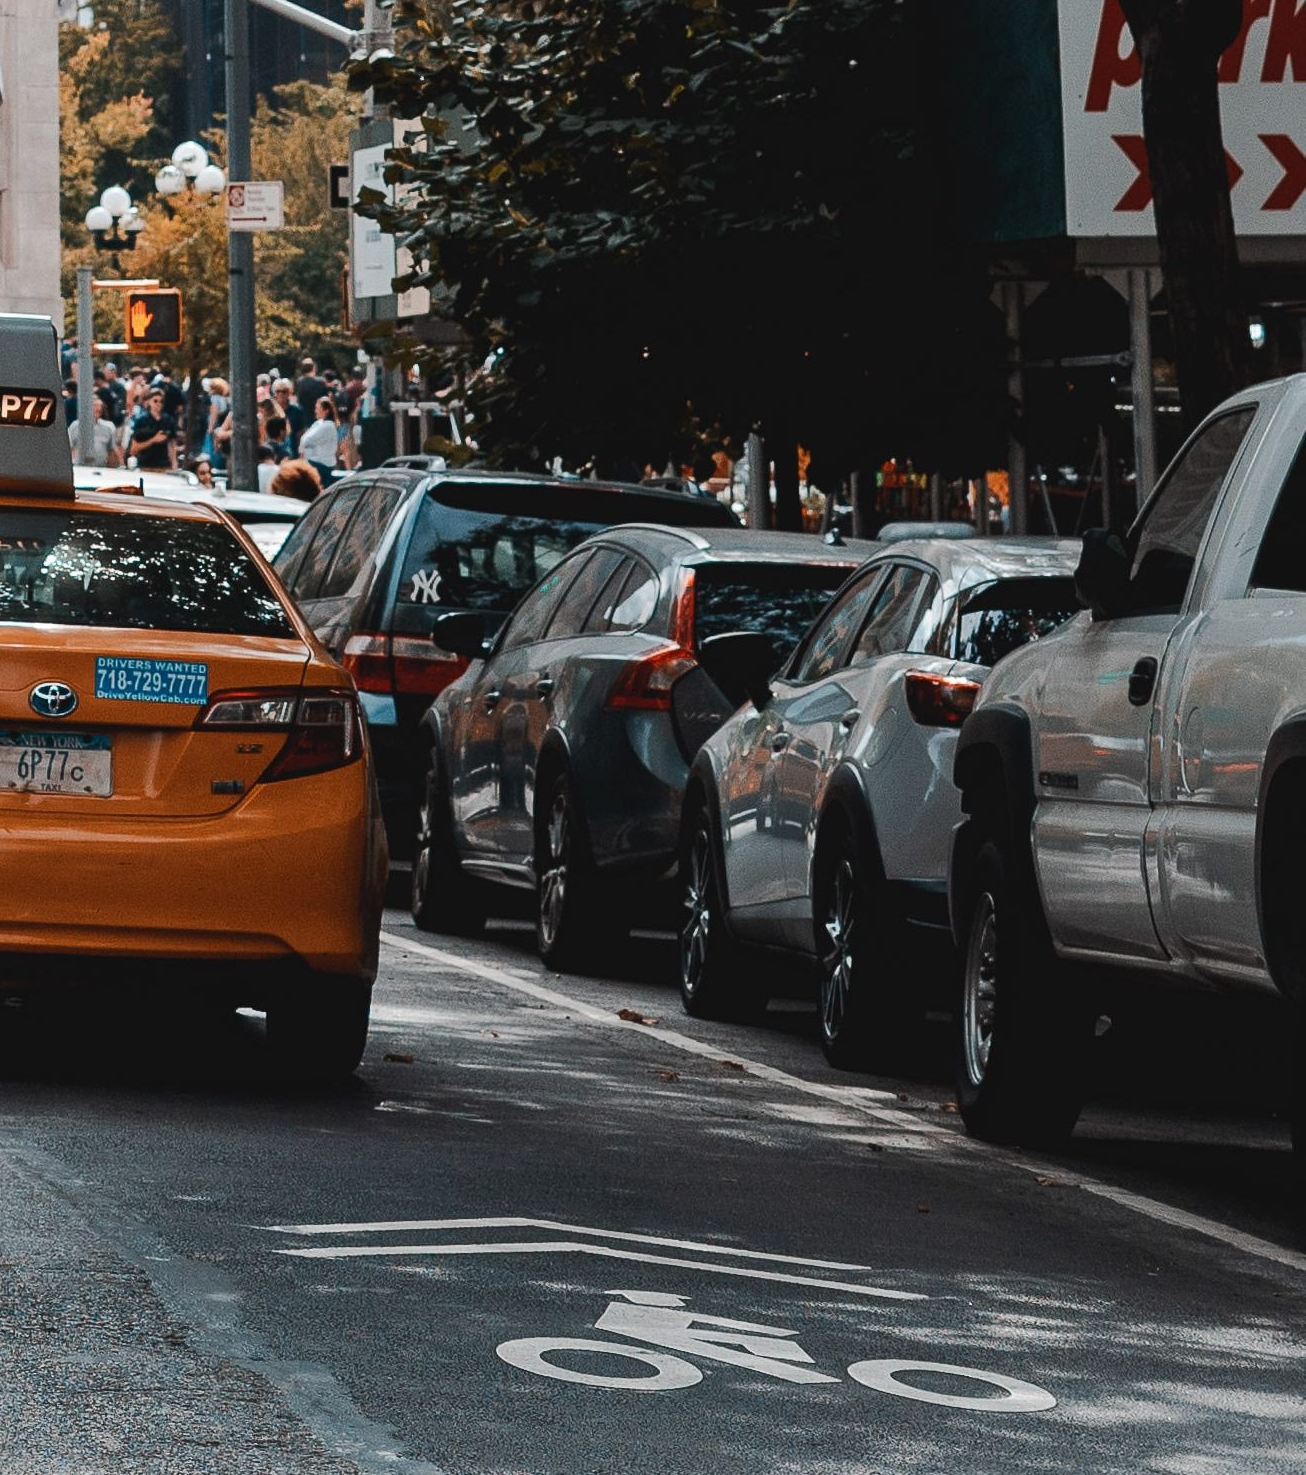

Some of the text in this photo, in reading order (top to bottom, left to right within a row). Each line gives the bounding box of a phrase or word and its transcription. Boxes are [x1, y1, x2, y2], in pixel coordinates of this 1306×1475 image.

[410, 569, 442, 603] NY
[98, 657, 207, 674] DRIVERS WANTED
[97, 669, 207, 696] 718-729-7777
[96, 690, 207, 705] DriveYellowCab.com
[20, 734, 84, 749] NEW YORK
[40, 783, 62, 792] TAXI
